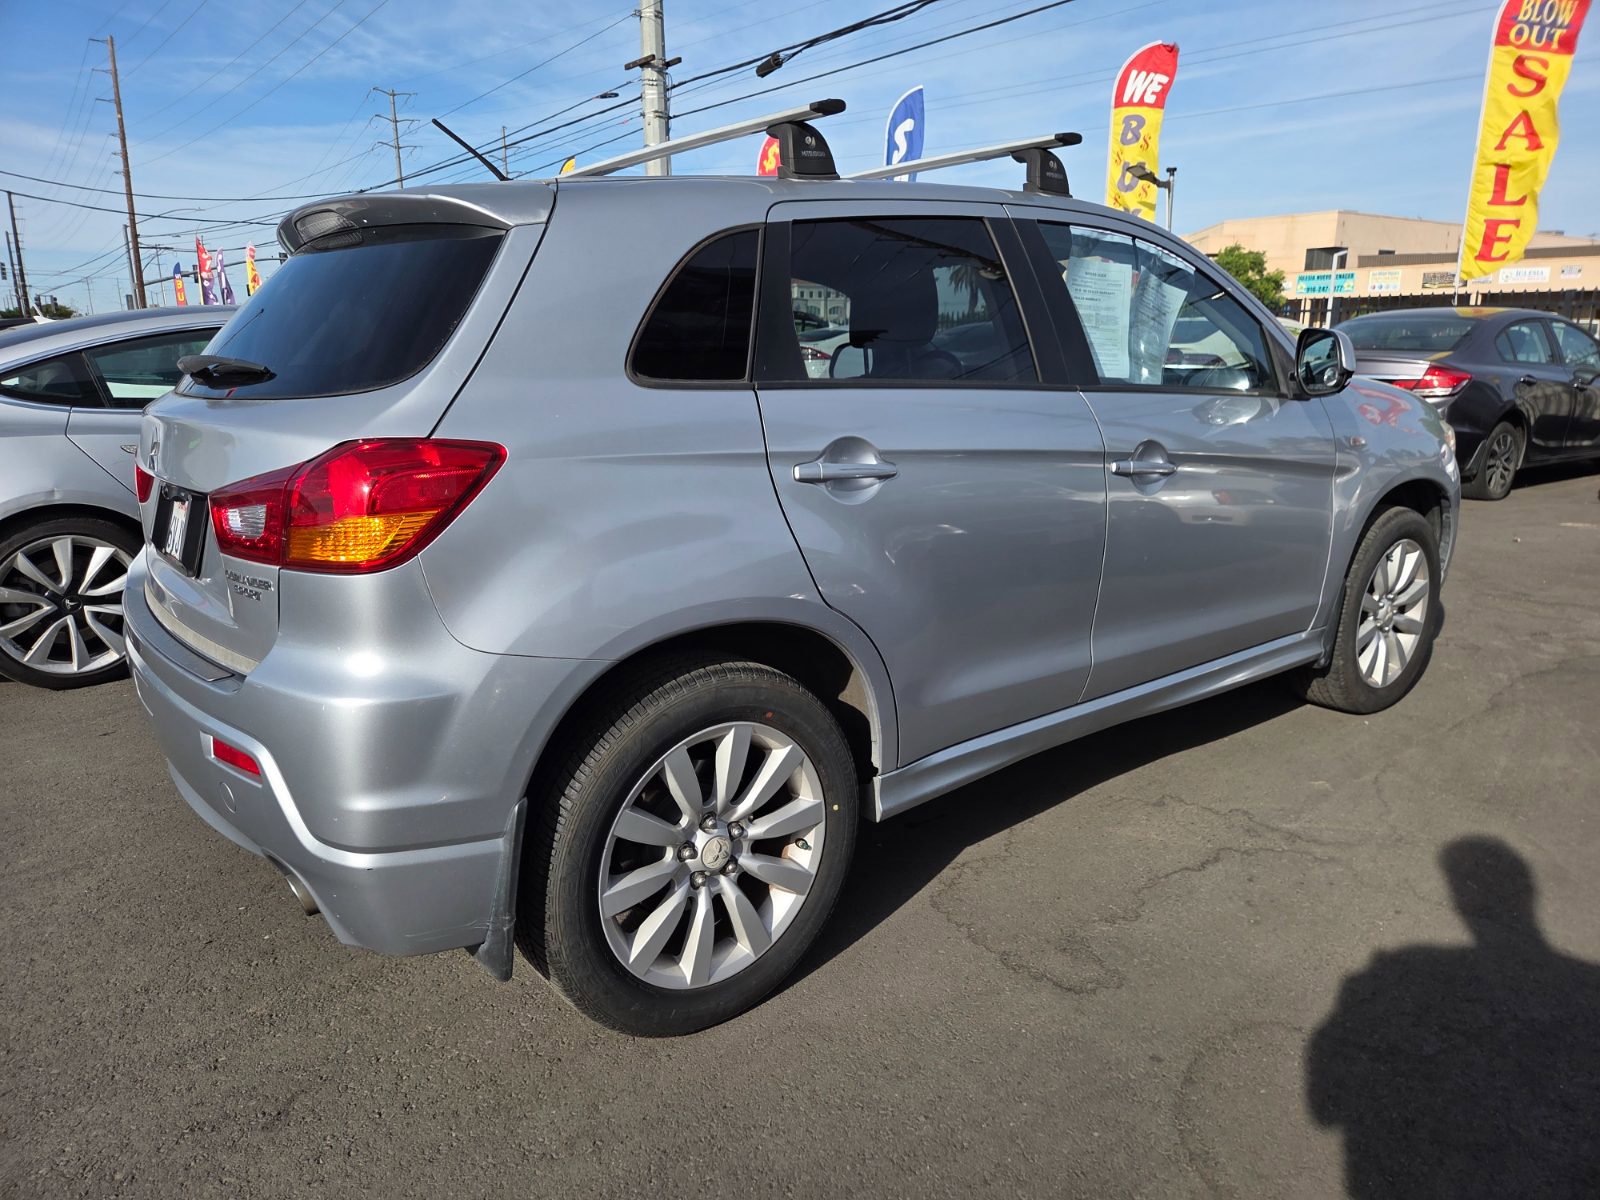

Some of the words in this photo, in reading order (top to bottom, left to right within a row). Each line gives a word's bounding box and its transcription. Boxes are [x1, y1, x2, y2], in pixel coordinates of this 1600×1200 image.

[1517, 0, 1579, 28] BLOW
[1508, 23, 1567, 49] OUT
[1122, 69, 1170, 105] WE
[1116, 114, 1147, 217] BU
[1474, 54, 1550, 263] SALE
